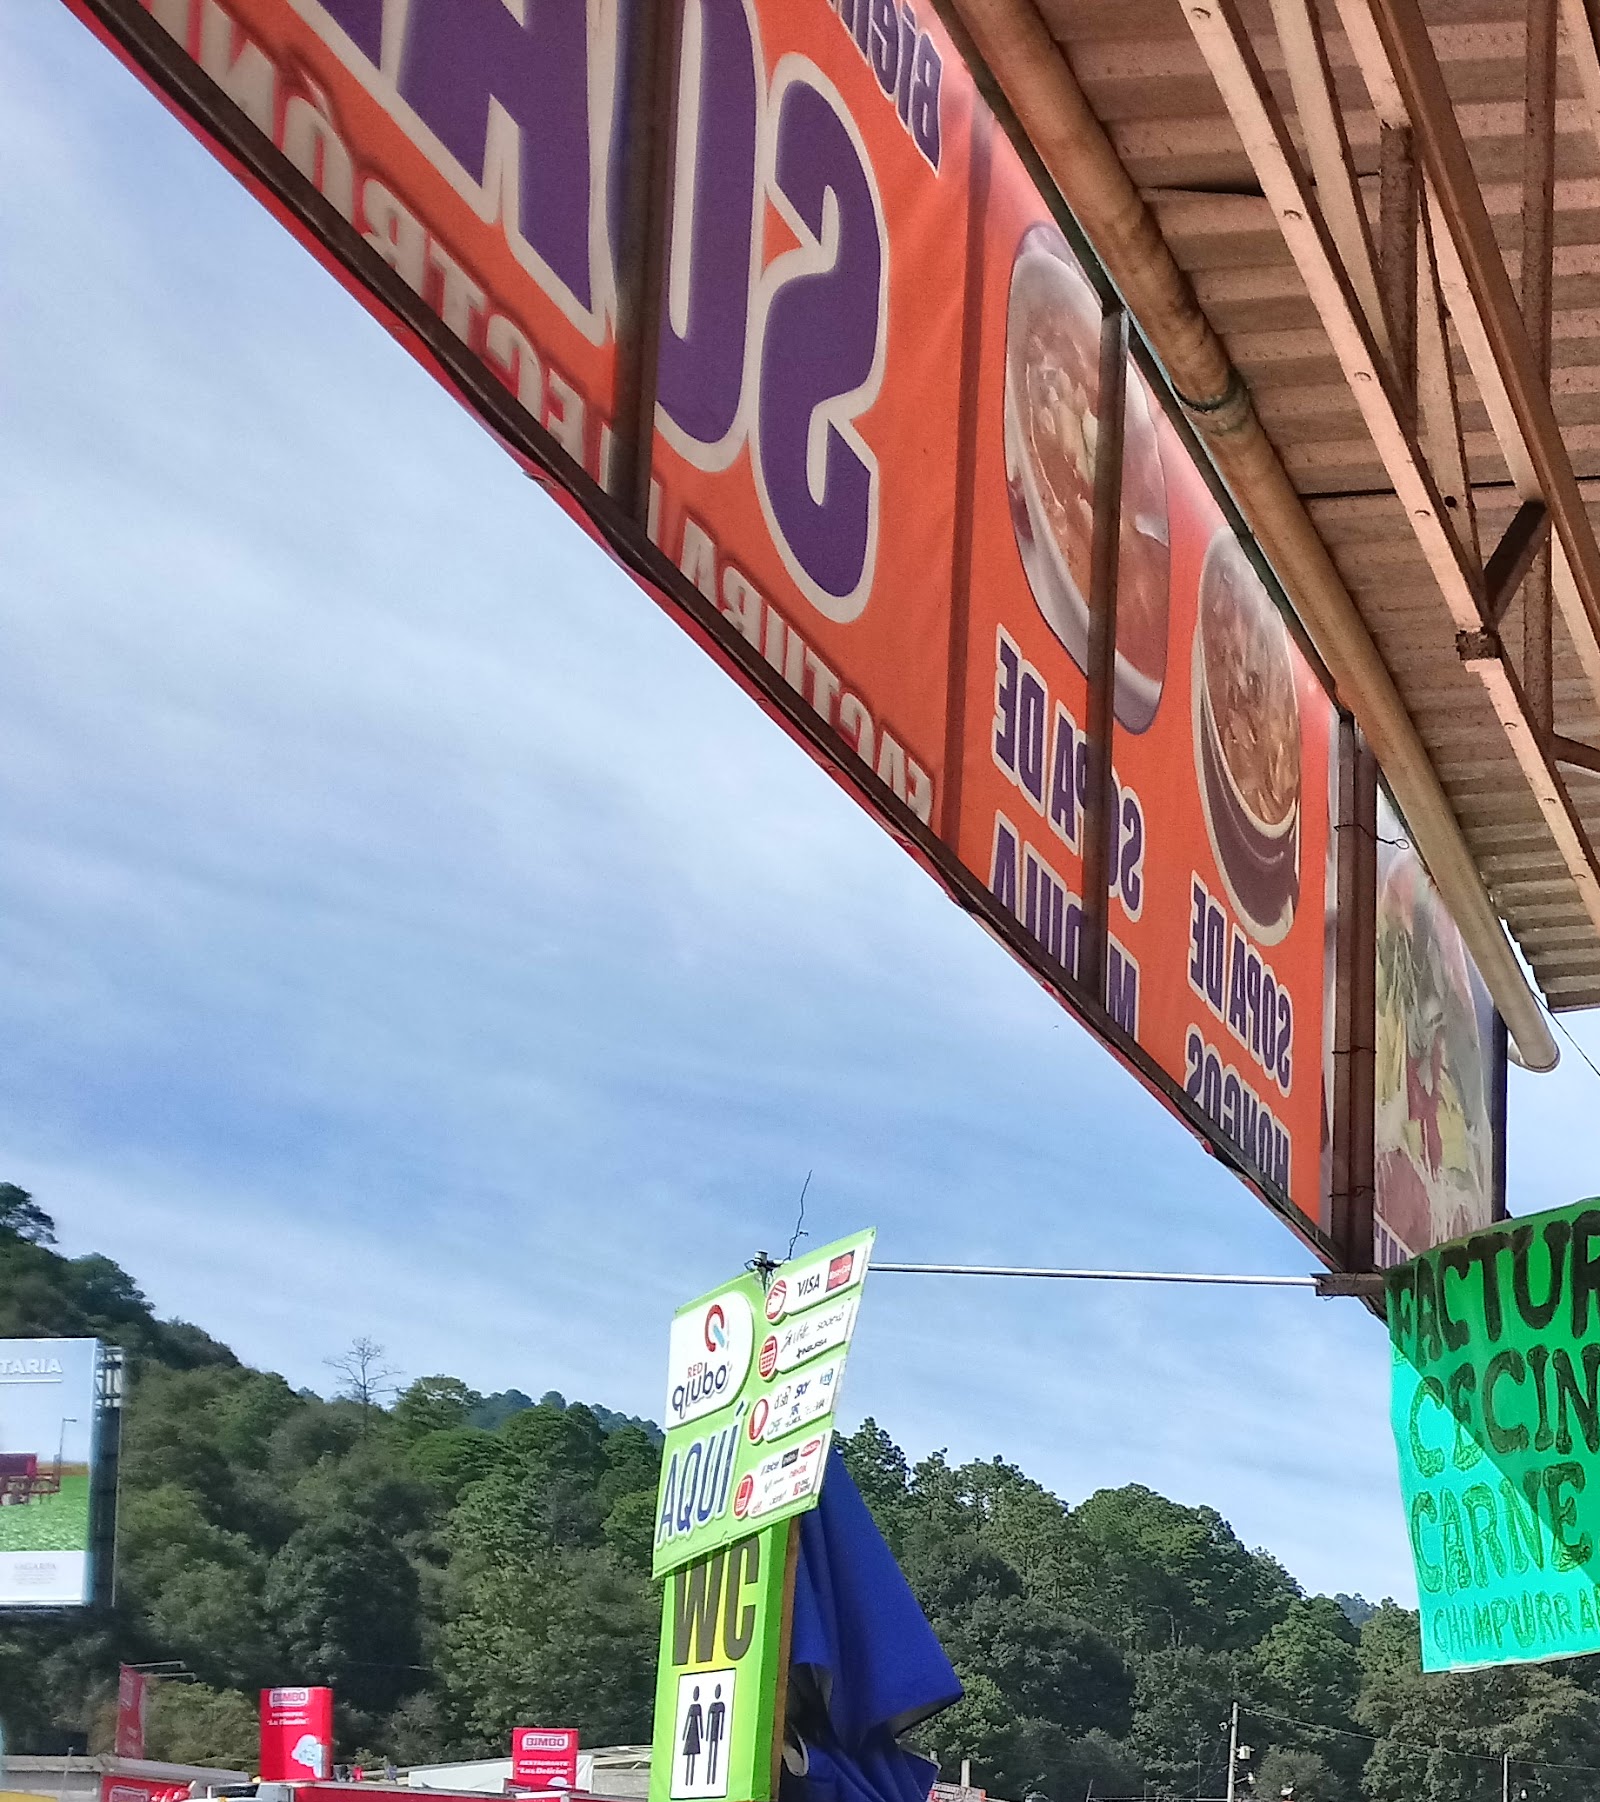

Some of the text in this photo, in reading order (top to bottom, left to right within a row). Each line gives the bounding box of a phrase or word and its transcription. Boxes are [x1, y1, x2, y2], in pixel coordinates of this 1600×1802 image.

[687, 1361, 704, 1379] RED
[656, 1399, 745, 1545] AQUÍ
[1411, 1461, 1592, 1596] CARNE
[672, 1535, 761, 1667] WC
